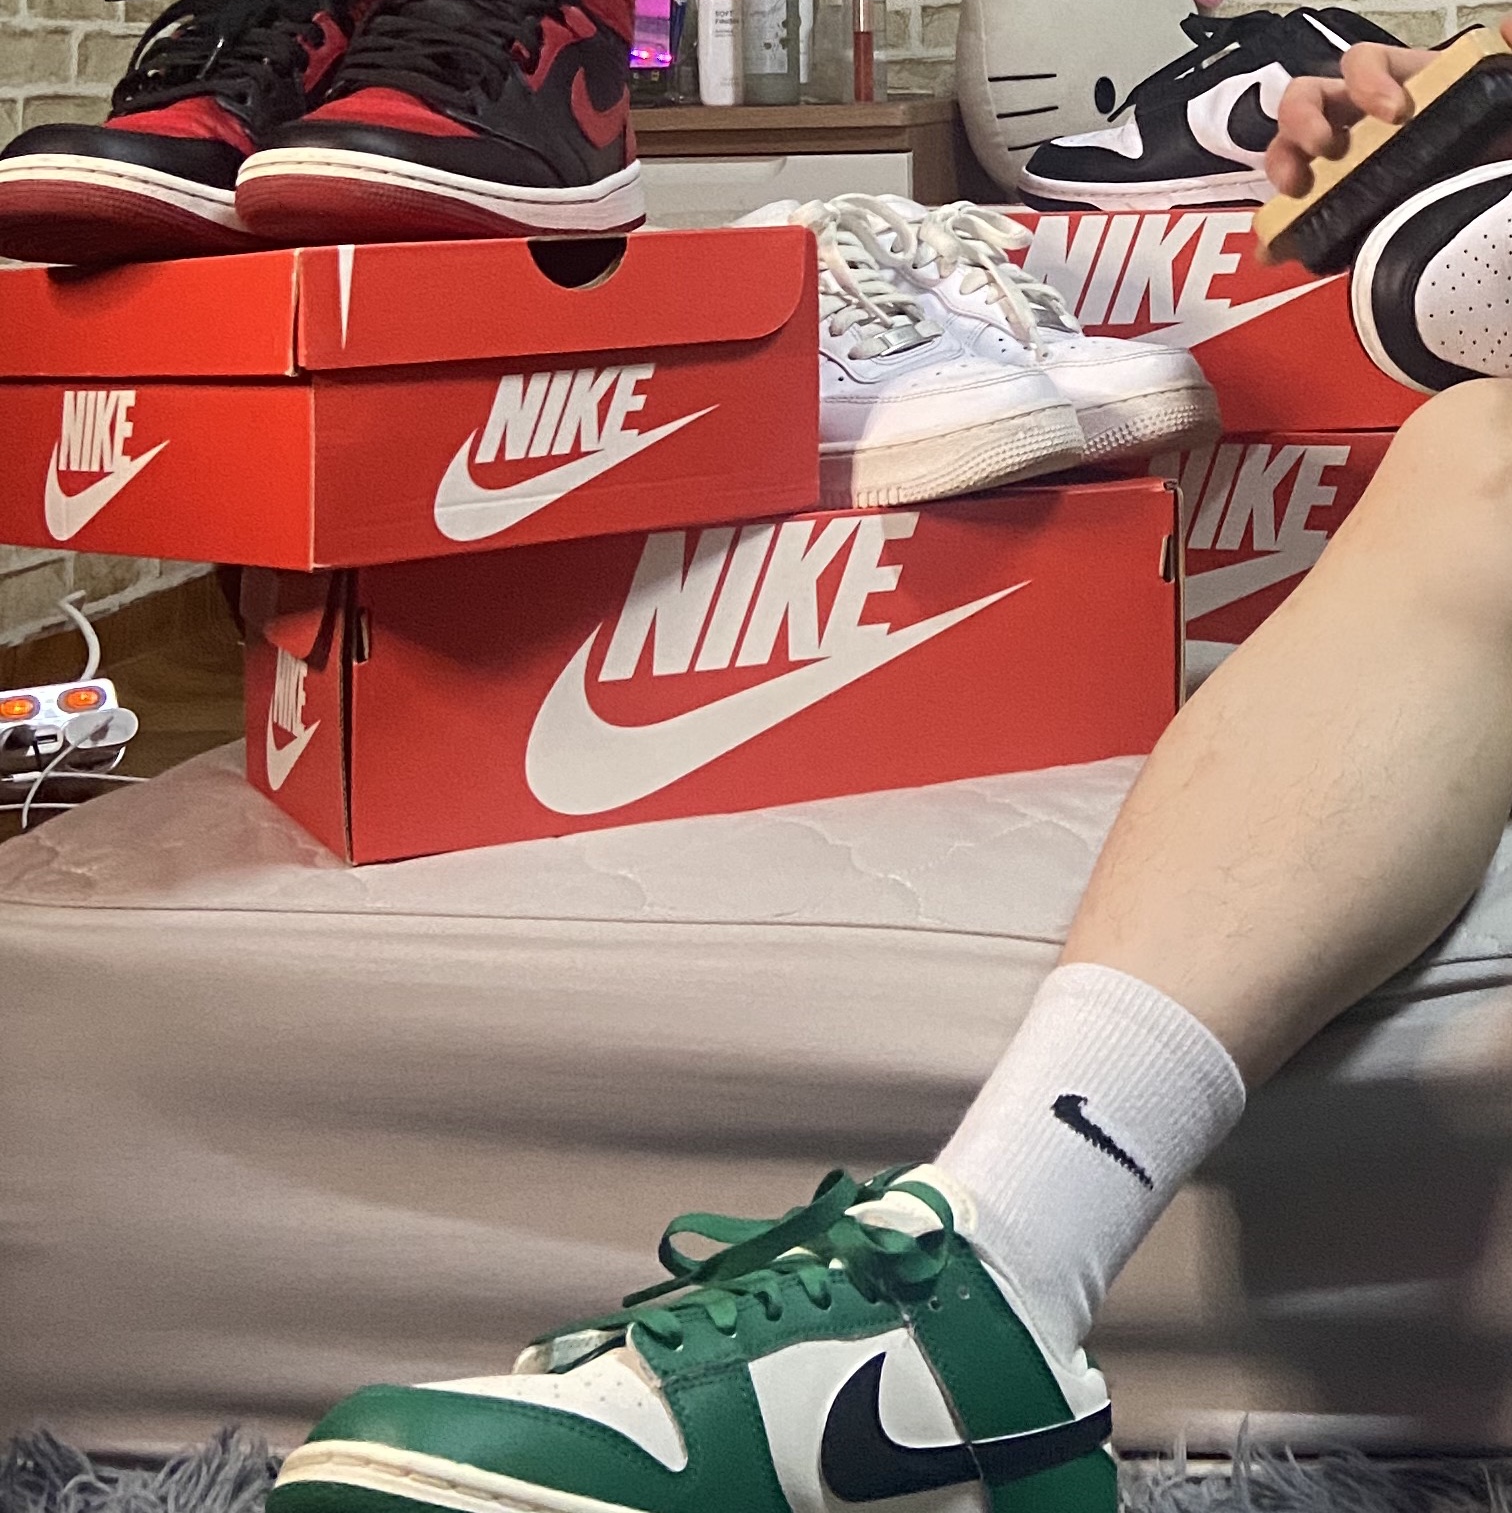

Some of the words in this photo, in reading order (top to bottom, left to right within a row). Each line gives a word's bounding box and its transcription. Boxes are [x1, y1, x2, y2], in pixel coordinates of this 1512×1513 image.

[1022, 212, 1253, 326] NIKE
[59, 389, 136, 473] NIKE
[474, 362, 655, 464] NIKE
[598, 511, 921, 682] NIKE
[273, 646, 309, 735] NIKE
